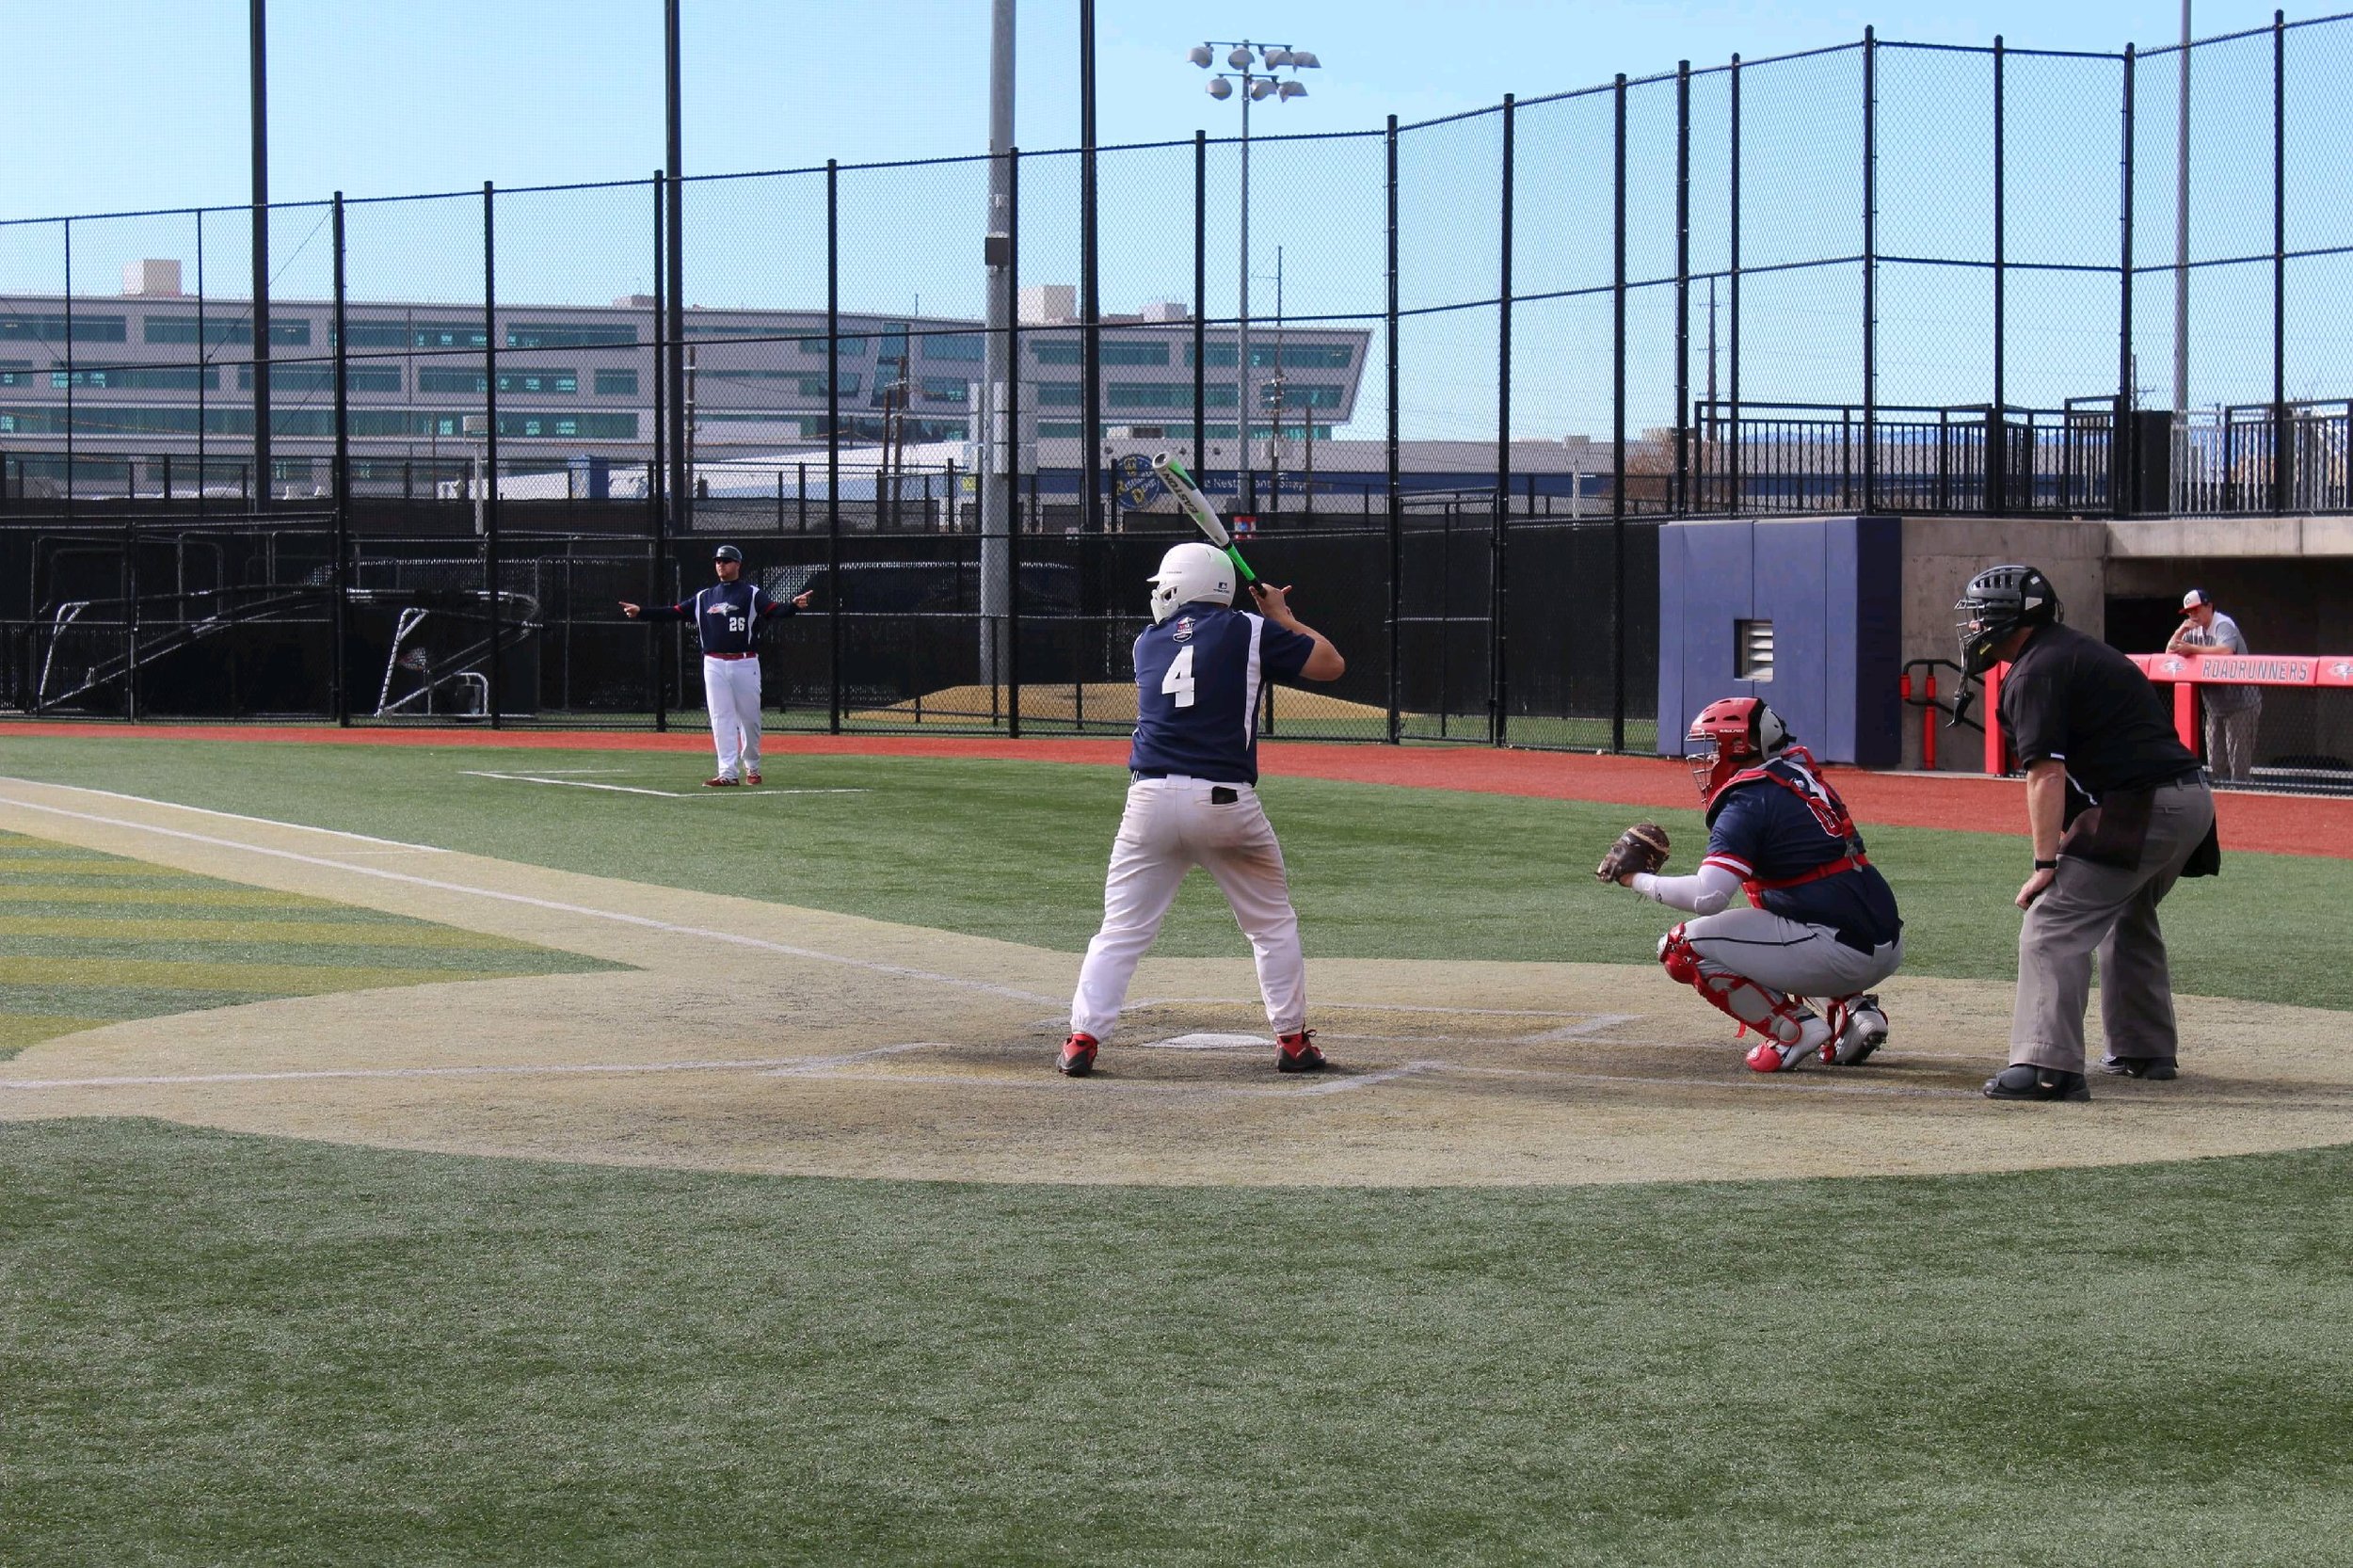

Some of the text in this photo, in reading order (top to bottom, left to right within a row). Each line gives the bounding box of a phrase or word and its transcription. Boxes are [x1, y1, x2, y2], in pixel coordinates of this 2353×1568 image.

[1161, 472, 1199, 514] EASTON
[729, 616, 745, 632] 26
[1161, 645, 1194, 708] 4
[2201, 659, 2308, 682] ROADRUNNERS
